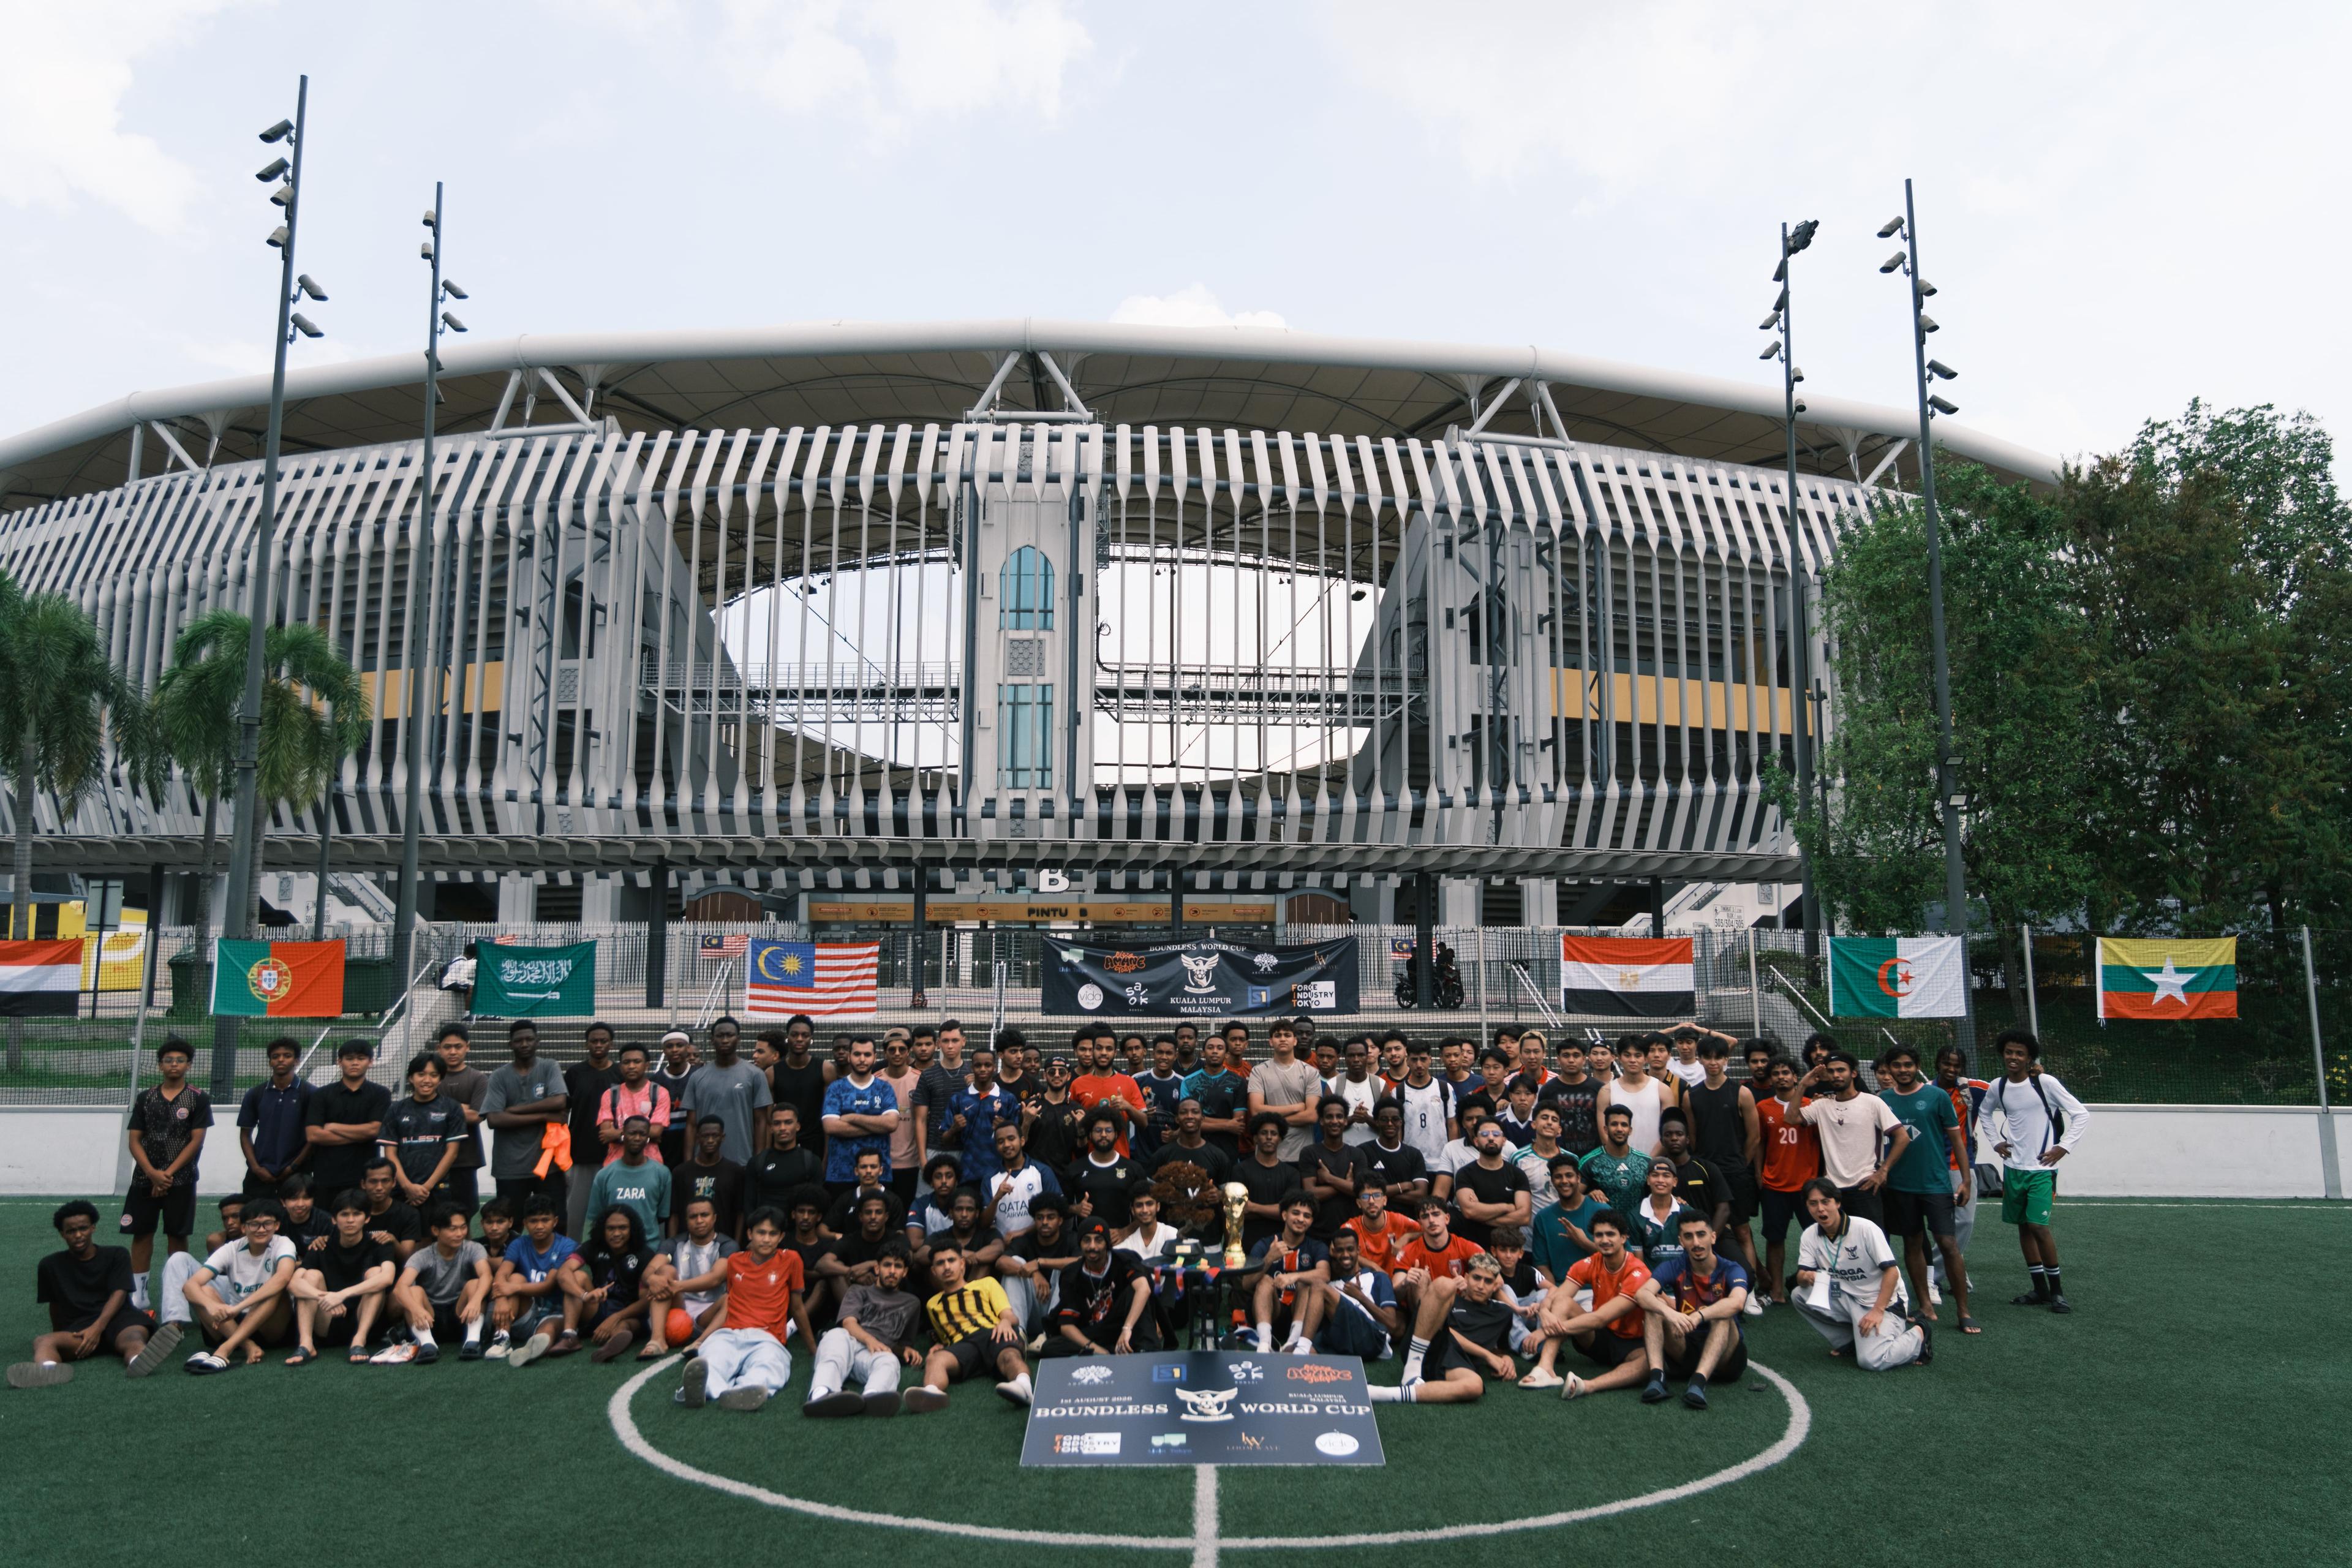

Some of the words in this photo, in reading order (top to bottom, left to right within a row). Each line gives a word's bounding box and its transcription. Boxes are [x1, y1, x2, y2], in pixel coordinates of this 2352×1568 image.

[1039, 869, 1070, 893] B
[1027, 908, 1068, 917] PINTU
[1079, 908, 1088, 917] B
[1715, 919, 1744, 928] 303/304/305
[1079, 990, 1101, 1000] vida
[1420, 1113, 1426, 1128] 8
[1779, 1127, 1797, 1144] 20
[616, 1187, 646, 1199] ZARA
[998, 1200, 1028, 1213] QATA
[1035, 1403, 1169, 1417] BOUNDLESS
[1240, 1403, 1318, 1414] WORLD
[1325, 1404, 1371, 1415] CUP
